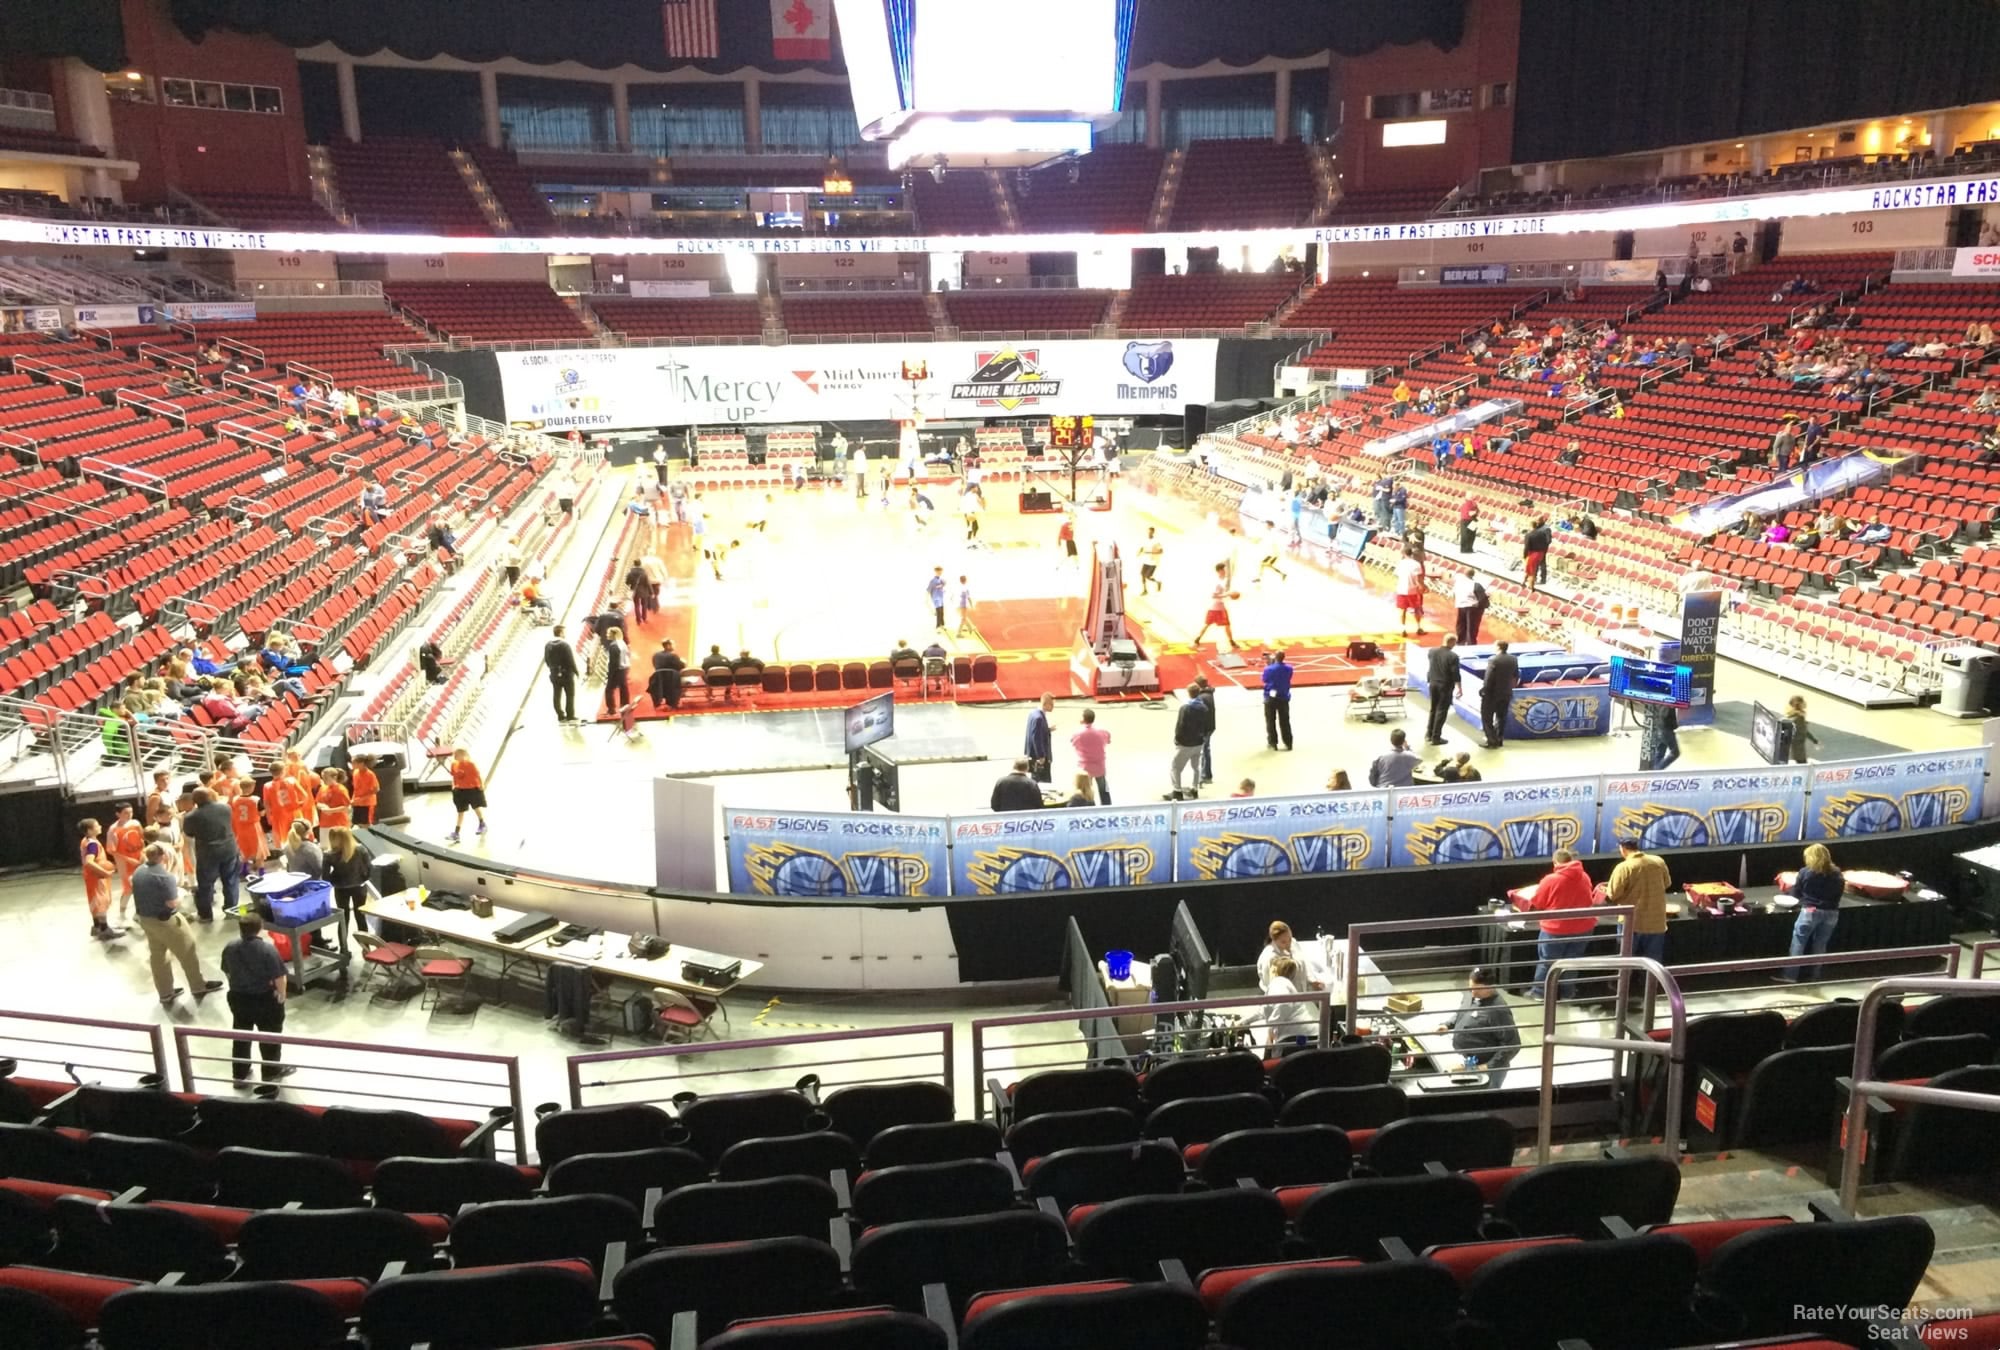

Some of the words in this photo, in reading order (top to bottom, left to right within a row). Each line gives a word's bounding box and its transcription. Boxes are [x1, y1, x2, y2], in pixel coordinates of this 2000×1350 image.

[1872, 184, 1957, 209] ROCKSTAR
[1315, 227, 1391, 242] ROCKSTAR
[1400, 224, 1434, 239] FAST
[1513, 218, 1545, 233] ZONE
[1852, 221, 1874, 233] 103
[45, 226, 110, 244] CKSTAR
[117, 229, 151, 245] FAST
[161, 230, 197, 248] SGNS
[764, 239, 800, 251] FAST
[894, 238, 928, 251] ZONE
[1691, 231, 1707, 242] 102
[1467, 243, 1484, 252] 101
[277, 256, 301, 267] 119
[834, 258, 855, 267] 122
[988, 257, 1008, 265] 124
[823, 367, 934, 380] MidAmern
[682, 375, 781, 413] Mercy
[953, 384, 1000, 398] PRAIRIE
[1003, 382, 1058, 396] MEADOWS
[1116, 383, 1178, 399] MEMPHIS
[1687, 617, 1716, 627] DON'T
[1688, 626, 1713, 637] JUST
[1682, 635, 1717, 646] WATCH
[1562, 699, 1599, 719] VIP
[1906, 757, 1983, 775] ROCKSTAR
[1712, 775, 1803, 791] ROCKSTAR
[1503, 785, 1593, 801] ROCKSTAR
[239, 804, 248, 821] 3
[1289, 799, 1384, 816] ROCKSTAR
[1905, 787, 1969, 828] VIP
[841, 820, 941, 838] ROCKSTAR
[1068, 814, 1166, 831] ROCKSTAR
[1712, 807, 1786, 844] VIP
[1505, 817, 1578, 857] VIP
[1291, 831, 1368, 872] VIP
[845, 855, 928, 896] VIP
[1071, 847, 1152, 888] VIP
